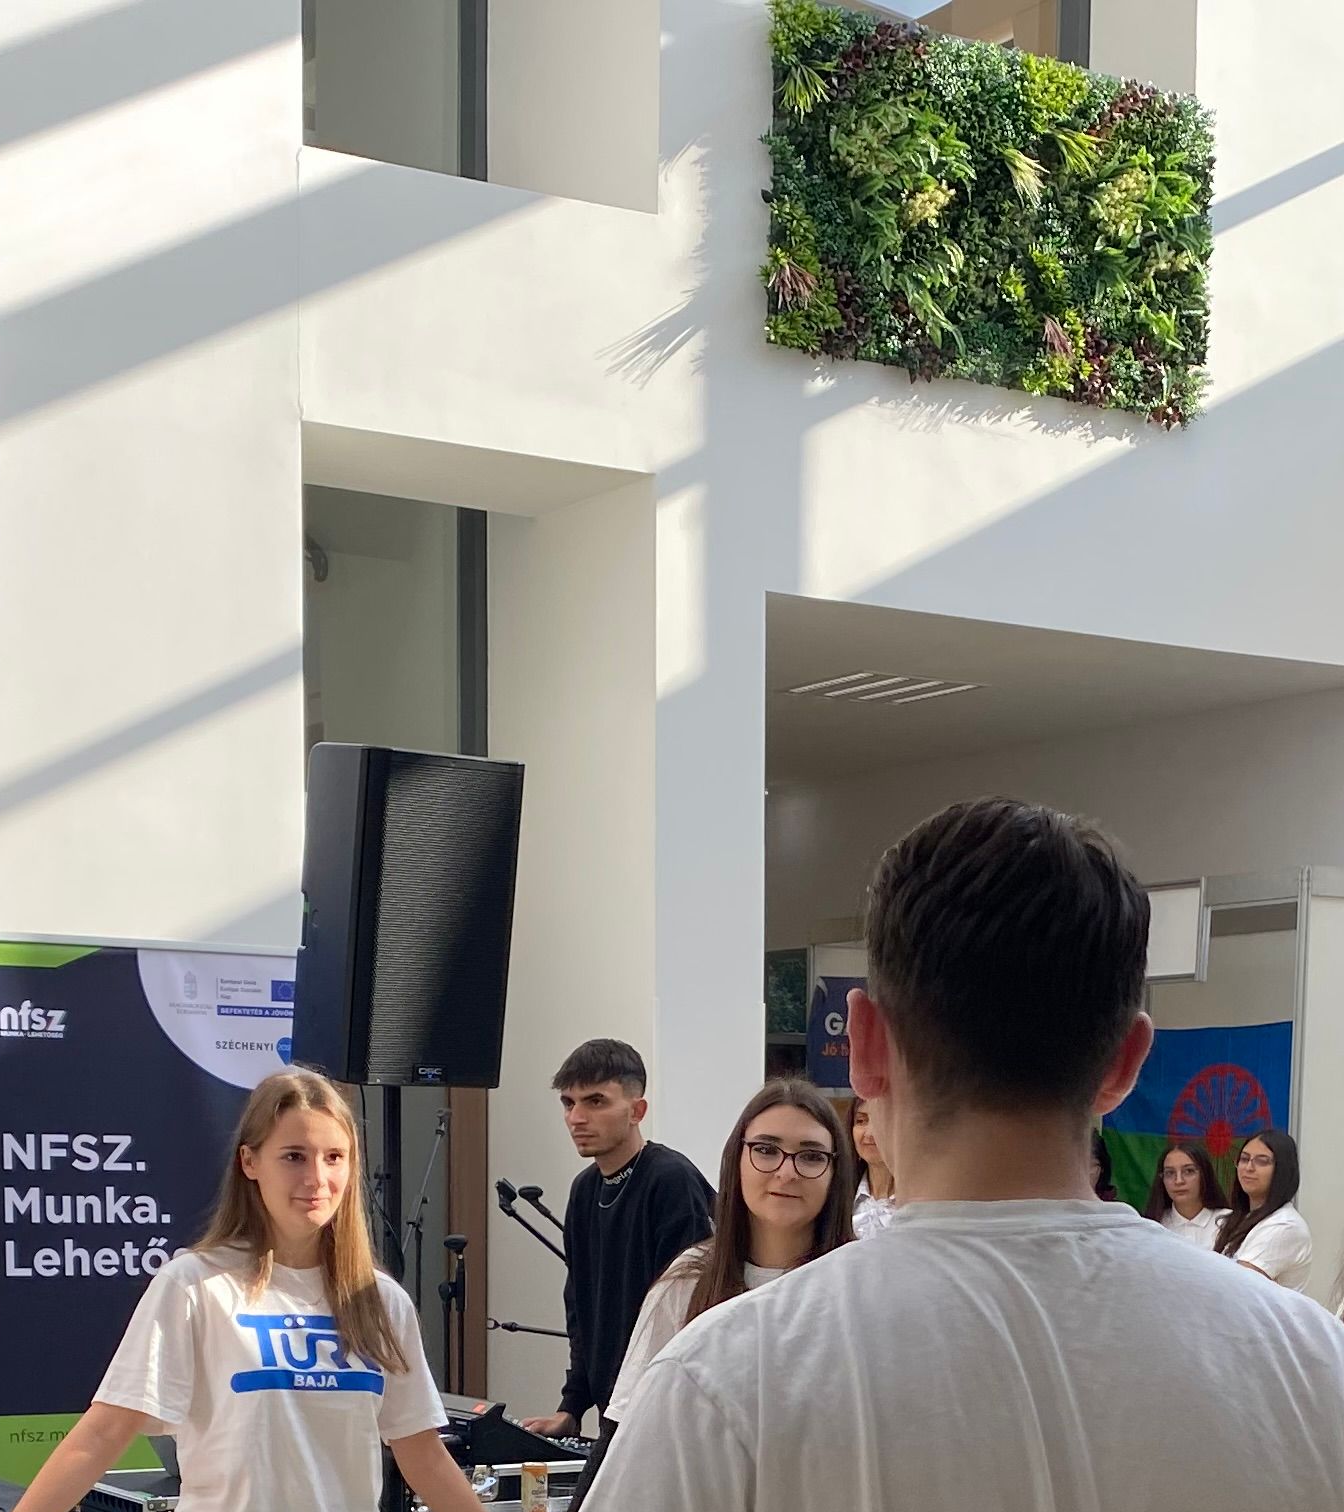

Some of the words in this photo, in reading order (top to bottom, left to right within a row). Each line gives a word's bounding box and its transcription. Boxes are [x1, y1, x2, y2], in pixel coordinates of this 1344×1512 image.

[0, 1000, 67, 1031] nfsz
[215, 1040, 274, 1052] SZÉCHENYI
[3, 1133, 146, 1172] NFSZ.
[4, 1186, 172, 1224] Munka.
[293, 1374, 338, 1388] BAJA
